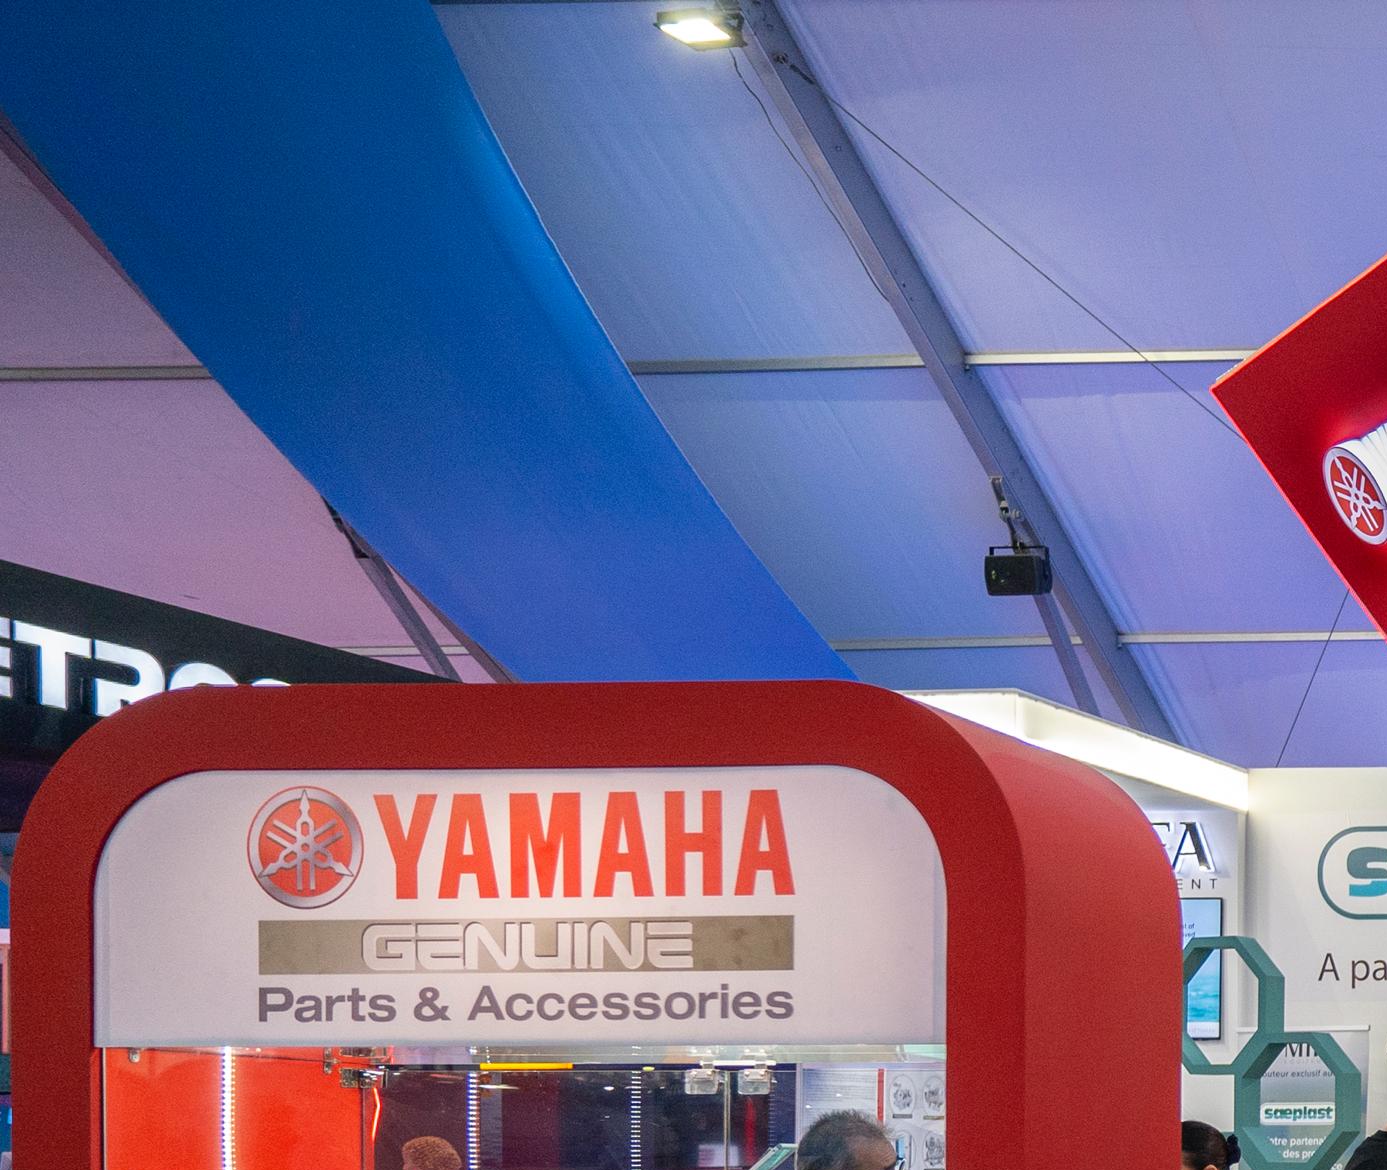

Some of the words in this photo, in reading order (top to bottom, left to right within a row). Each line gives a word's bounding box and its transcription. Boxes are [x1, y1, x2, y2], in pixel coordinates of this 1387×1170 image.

[373, 789, 796, 901] YAMAHA
[361, 919, 694, 973] GENUINE
[1318, 953, 1340, 981] A
[258, 986, 397, 1023] Parts
[412, 986, 452, 1023] &
[467, 984, 794, 1024] Accessories
[1282, 1149, 1300, 1159] des
